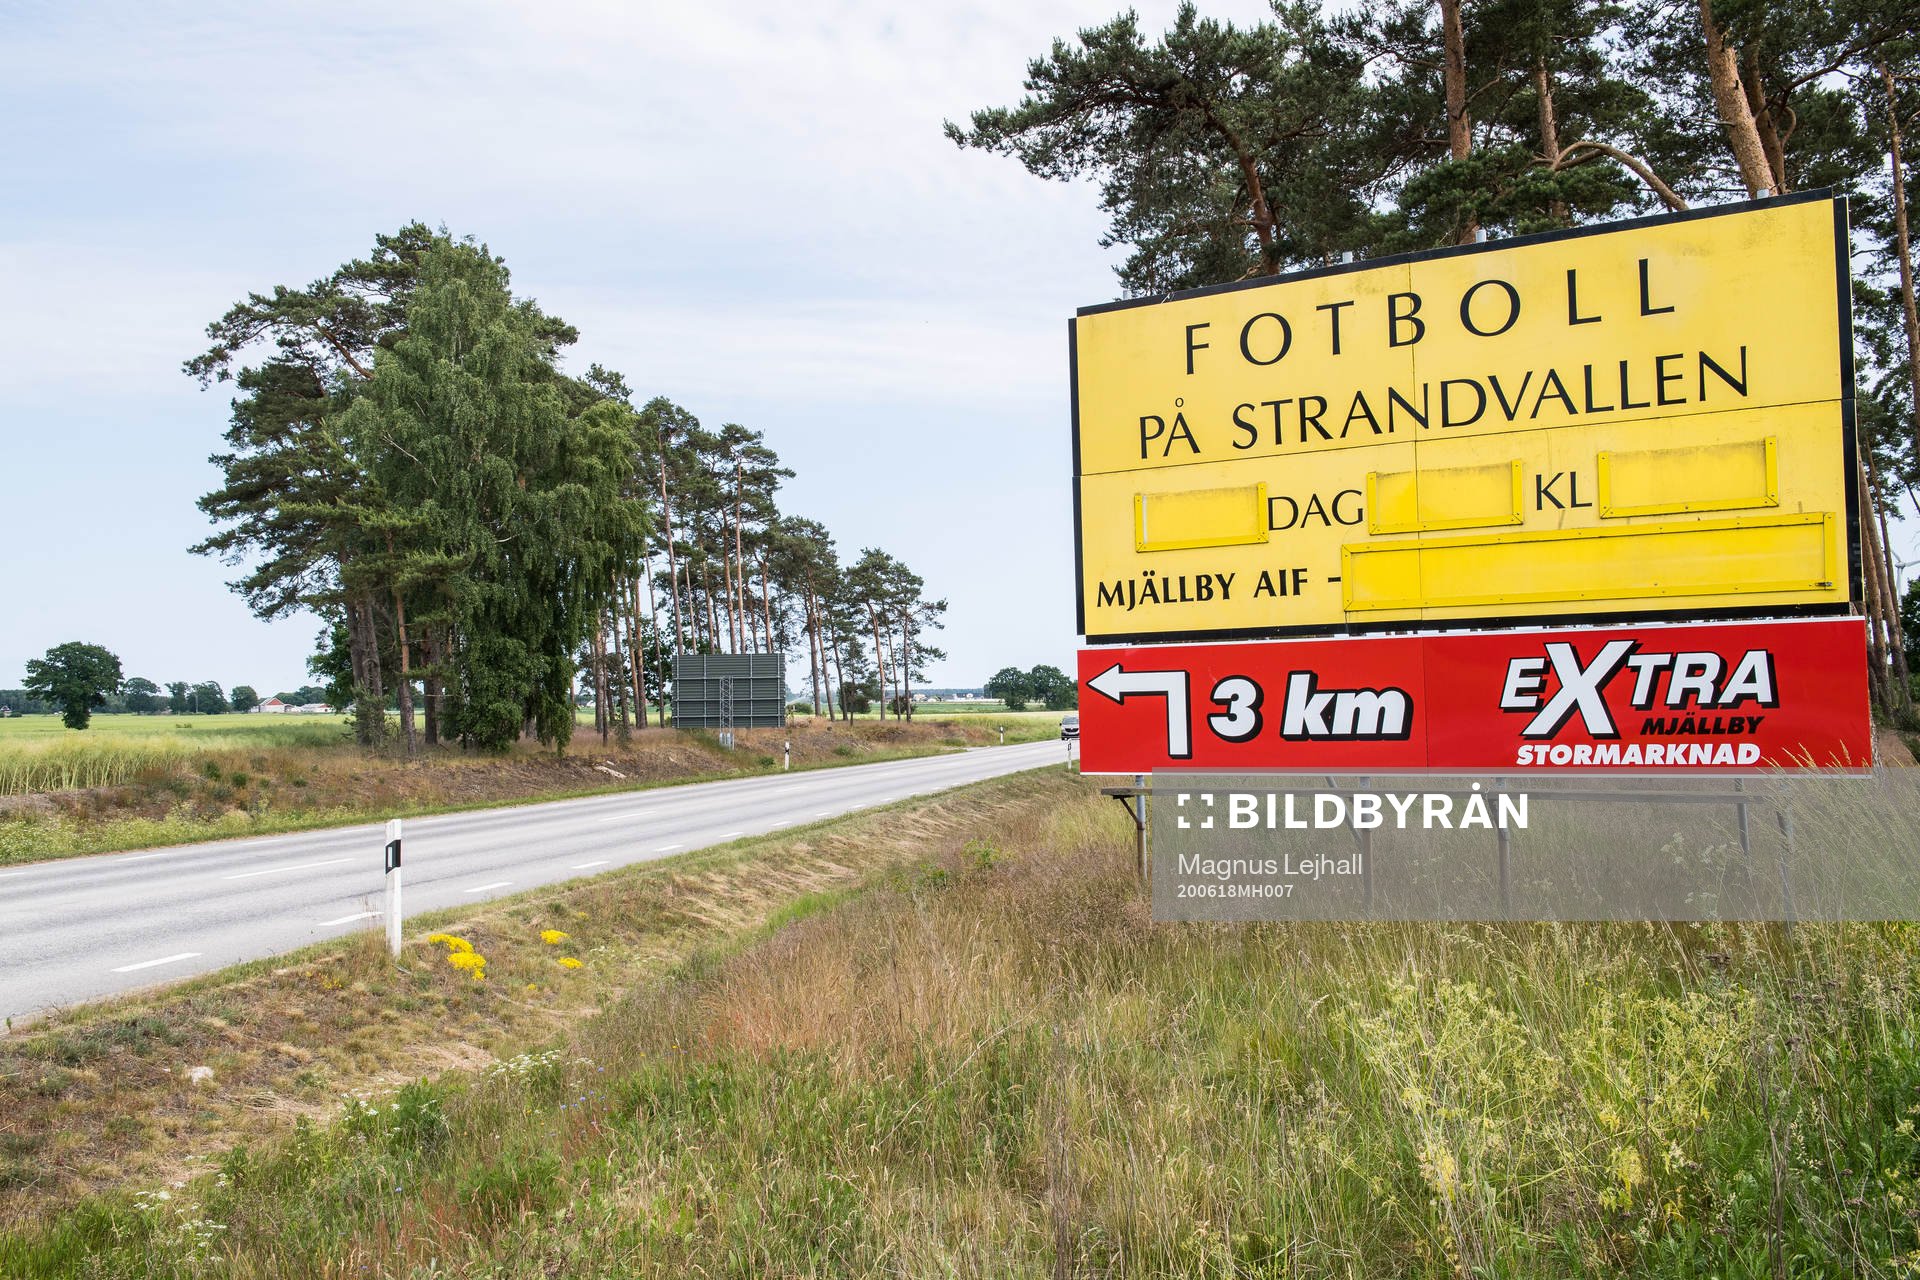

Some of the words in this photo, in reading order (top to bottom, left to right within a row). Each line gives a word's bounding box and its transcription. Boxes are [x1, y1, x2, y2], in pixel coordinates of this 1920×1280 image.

[1185, 258, 1675, 375] FOTBOLL
[1139, 397, 1201, 459] PÅ
[1232, 345, 1747, 449] STRANDVALLEN
[1267, 489, 1364, 531] DAG
[1535, 471, 1593, 511] KL
[1097, 570, 1236, 611] MJÄLLBY
[1253, 568, 1308, 598] AIF
[1207, 674, 1264, 743] 3
[1280, 670, 1414, 741] km
[1500, 639, 1780, 740] EXTRA
[1516, 743, 1761, 765] STORMARKNAD
[1640, 712, 1765, 735] MJÄLLBY
